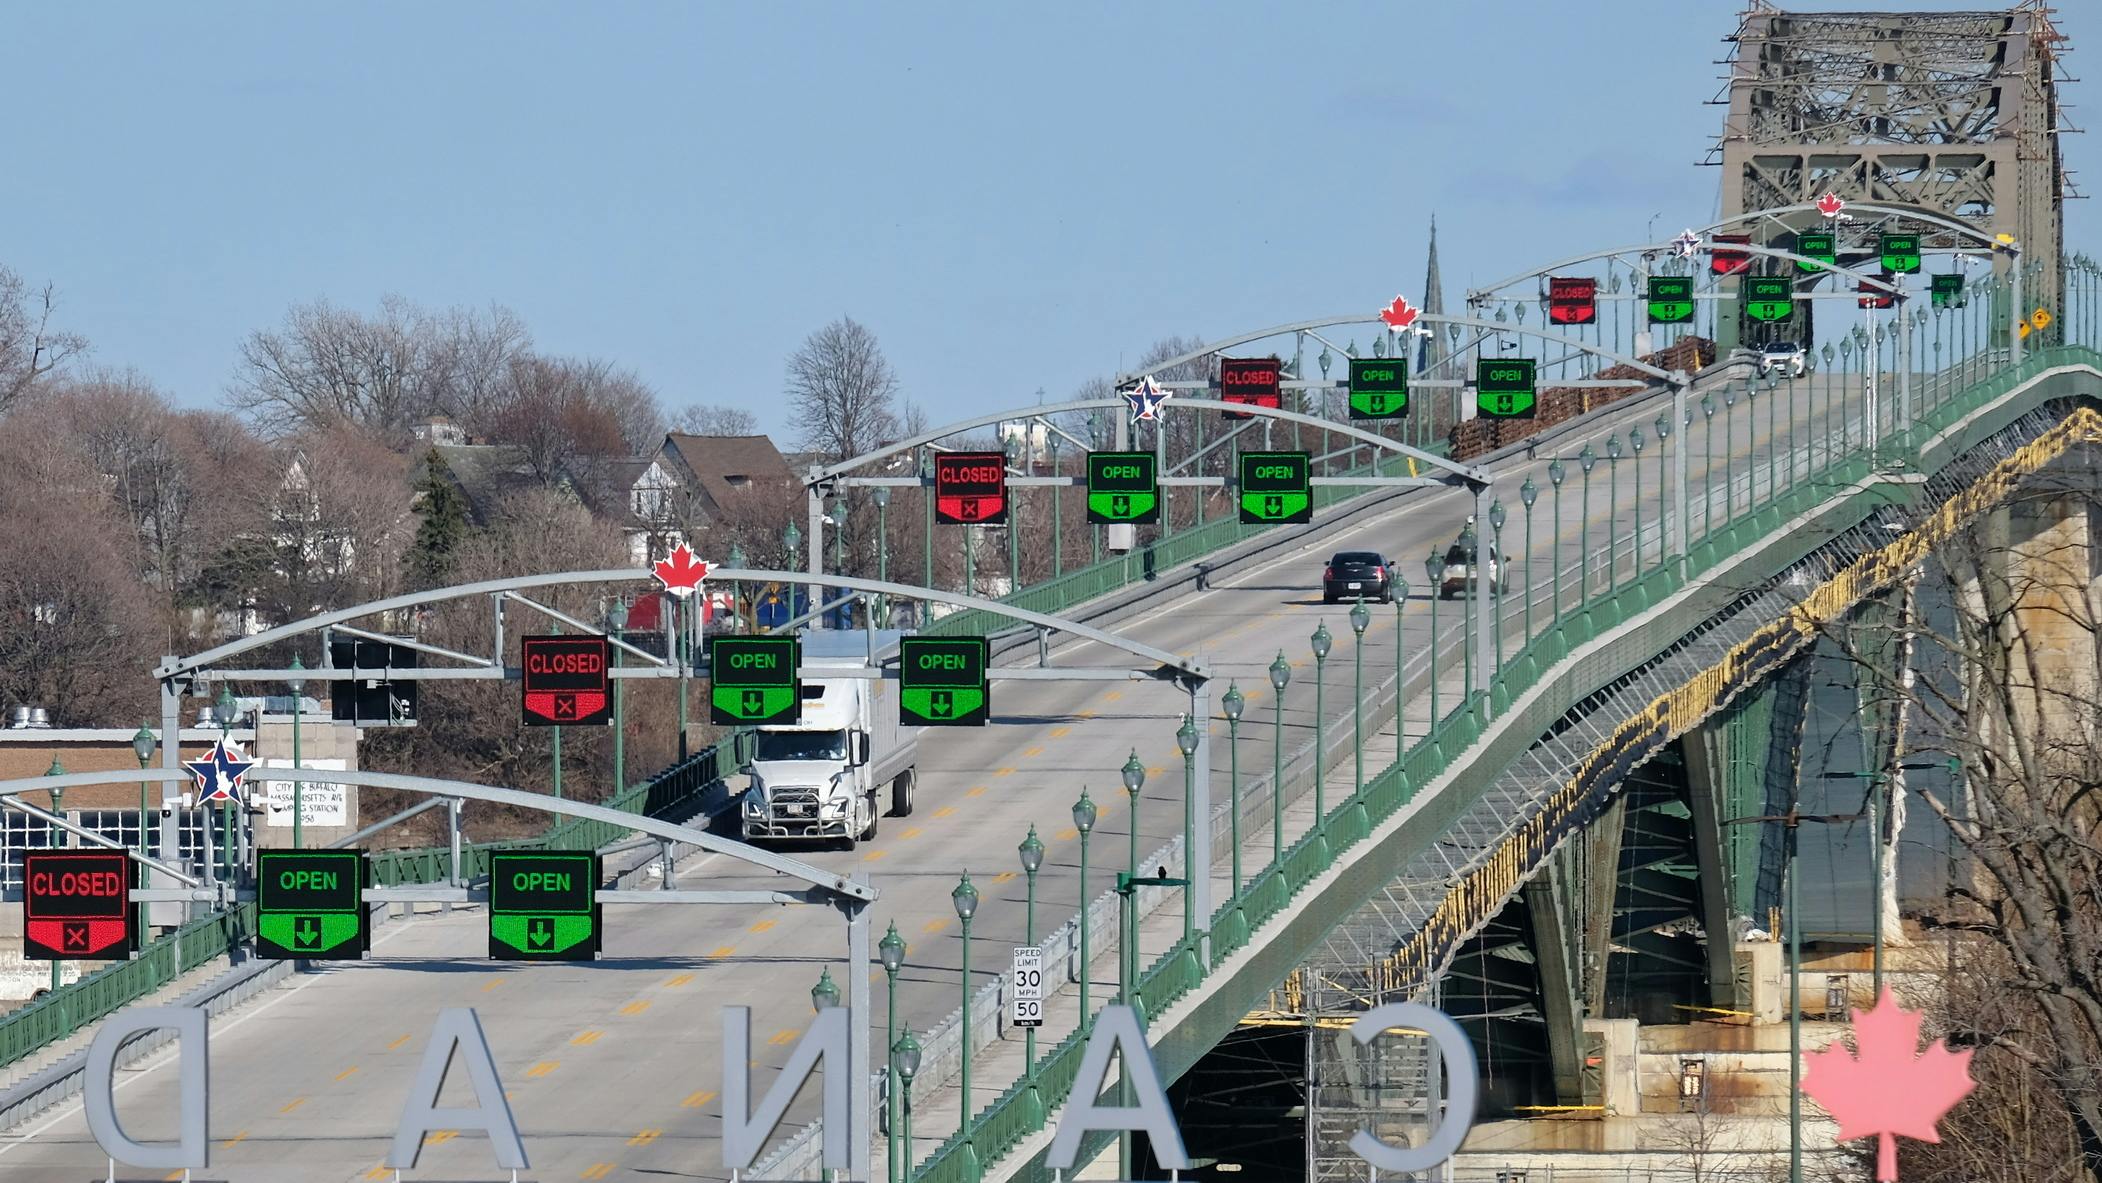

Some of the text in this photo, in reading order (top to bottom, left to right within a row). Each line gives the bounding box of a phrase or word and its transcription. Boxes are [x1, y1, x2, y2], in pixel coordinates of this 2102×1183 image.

[1889, 240, 1913, 250] OPEN
[1552, 286, 1592, 299] CLOSED
[1657, 284, 1684, 295] OPEN
[1755, 283, 1784, 295] OPEN
[1225, 371, 1276, 385] CLOSED
[1362, 370, 1395, 381] OPEN
[1489, 370, 1522, 381] OPEN
[940, 466, 1000, 484] CLOSED
[1102, 465, 1141, 479] OPEN
[1255, 465, 1294, 480] OPEN
[529, 653, 601, 674] CLOSED
[730, 653, 777, 669] OPEN
[919, 654, 967, 670] OPEN
[275, 784, 292, 792] CITY
[309, 804, 338, 813] STATION
[33, 872, 119, 896] CLOSED
[279, 871, 337, 891] OPEN
[512, 872, 571, 892] OPEN
[1014, 949, 1041, 957] SPEED
[1017, 958, 1038, 967] LIMIT
[1016, 970, 1041, 987] 30
[1017, 1002, 1038, 1016] 50
